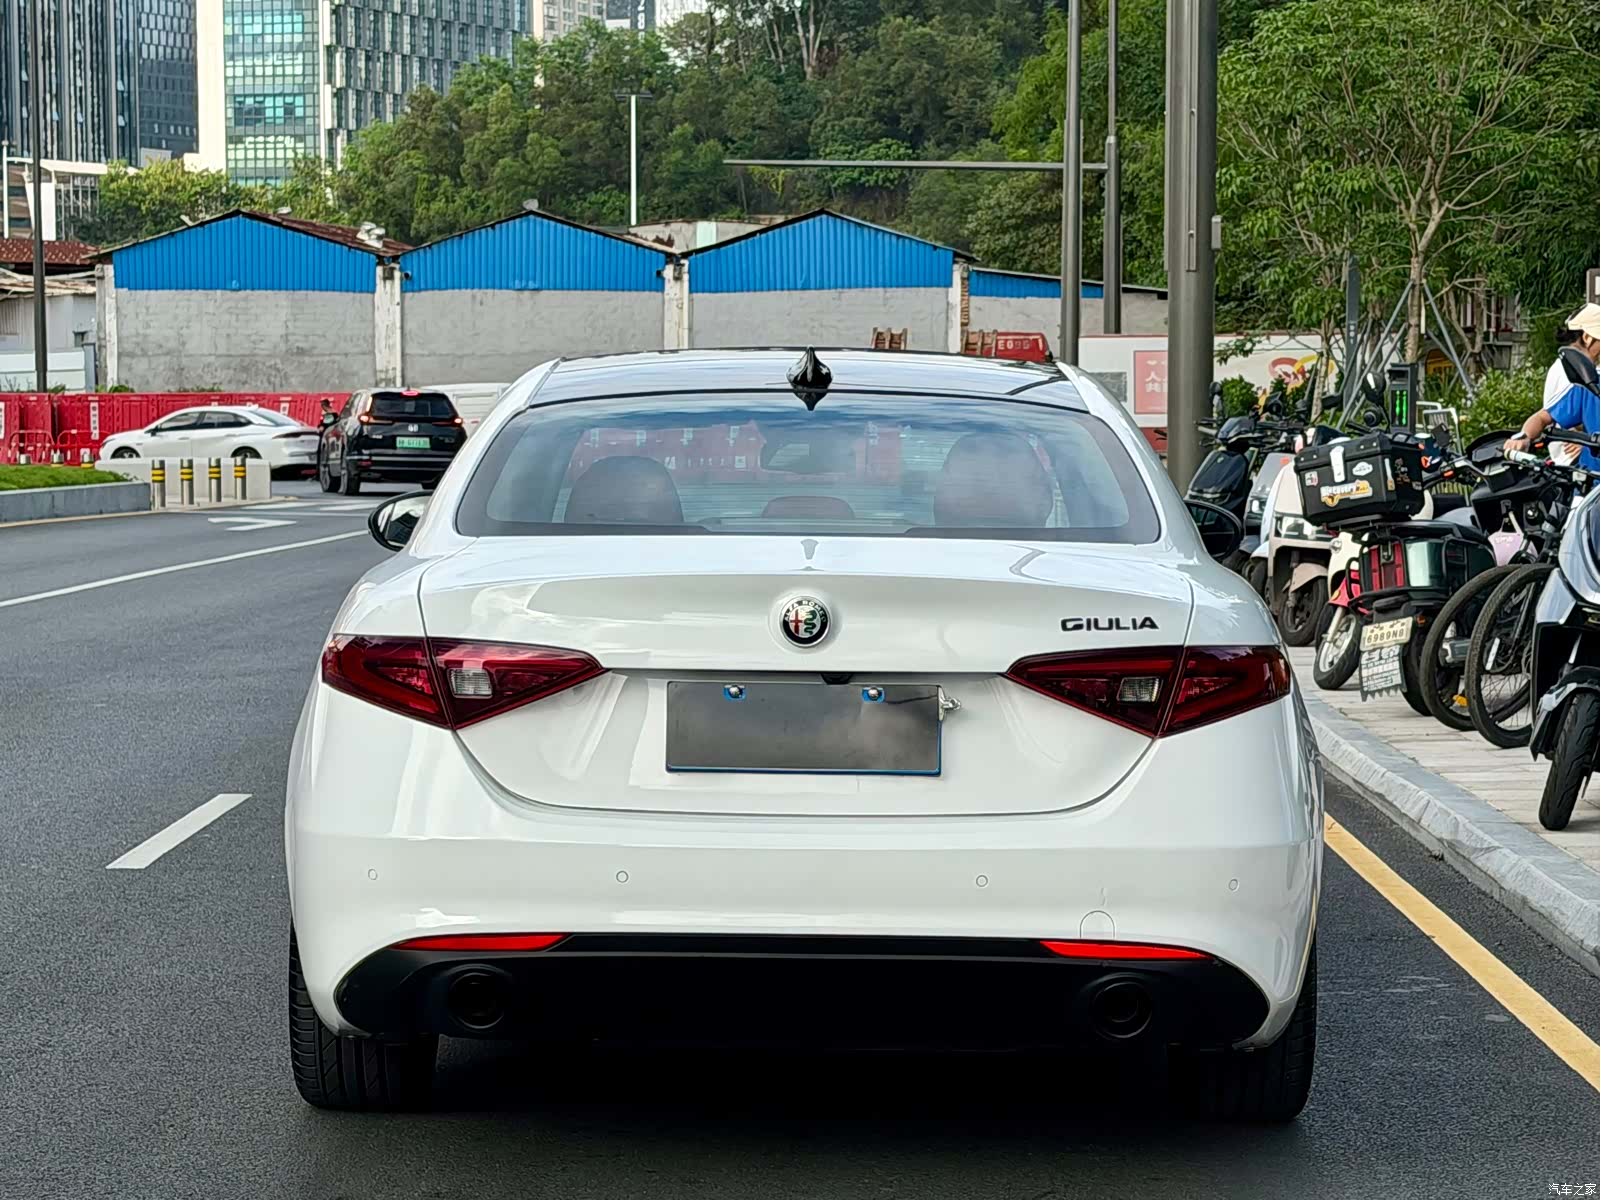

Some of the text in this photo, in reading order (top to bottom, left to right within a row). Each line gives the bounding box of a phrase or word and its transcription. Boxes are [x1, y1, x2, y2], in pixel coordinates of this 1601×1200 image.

[784, 600, 827, 622] ALFA ROMEO
[1060, 616, 1160, 632] GIULIA
